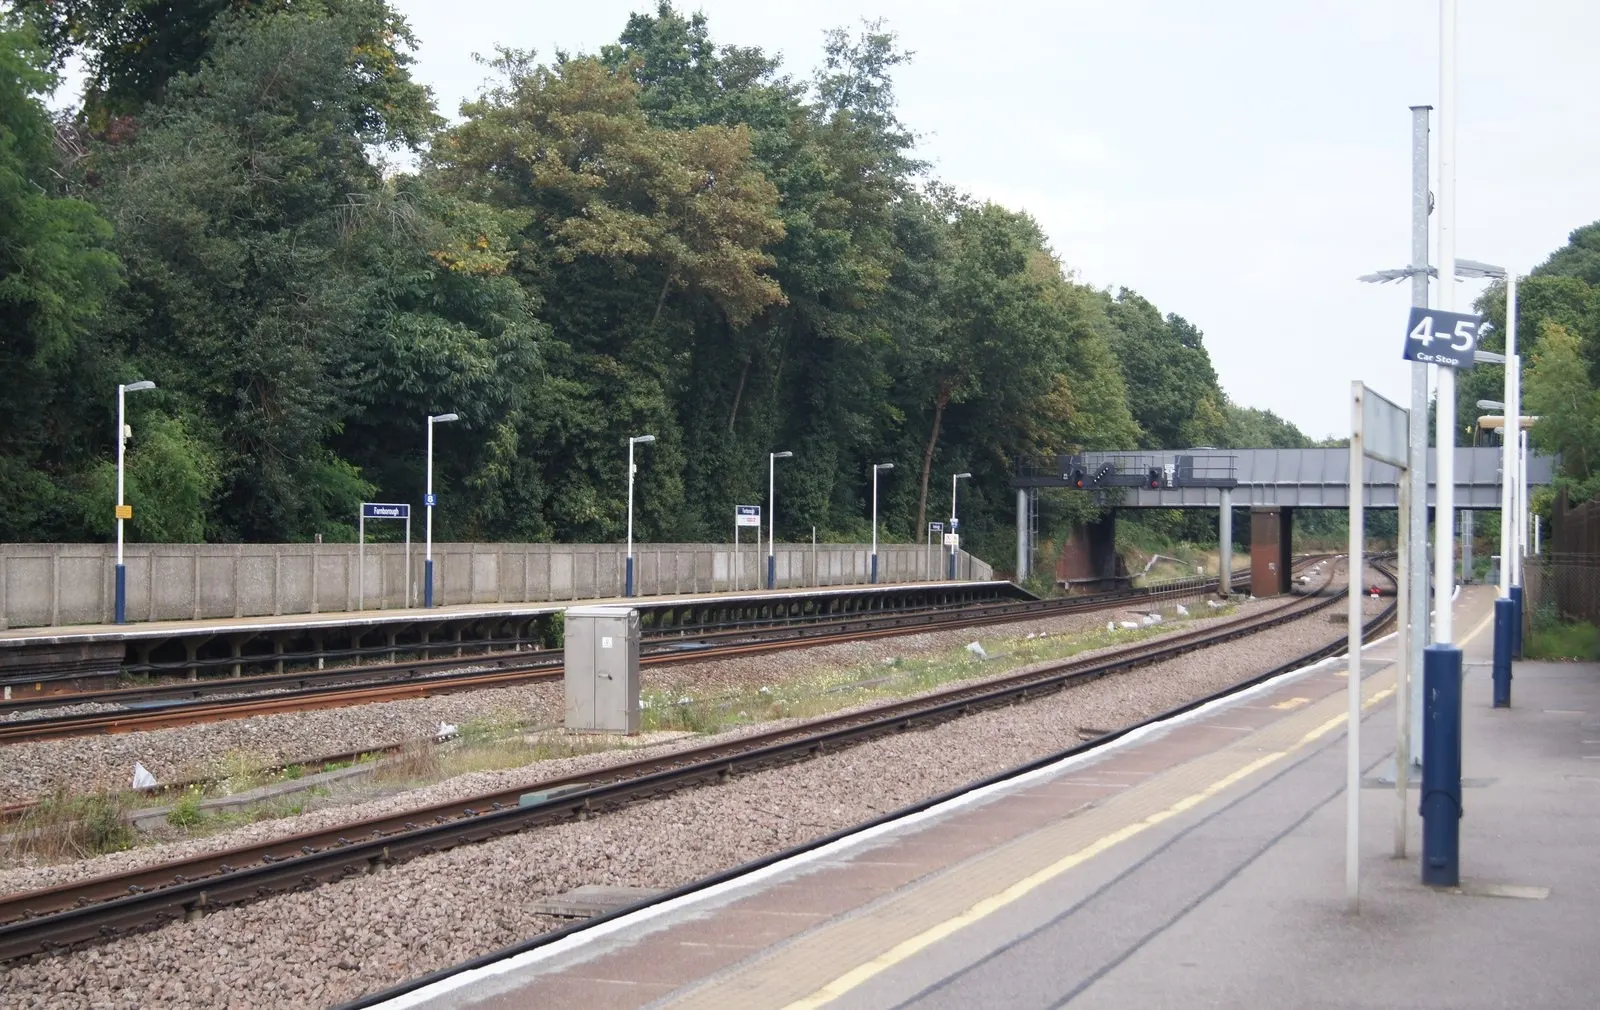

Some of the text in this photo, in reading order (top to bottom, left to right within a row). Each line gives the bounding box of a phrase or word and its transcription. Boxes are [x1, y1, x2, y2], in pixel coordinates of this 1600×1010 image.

[1409, 316, 1475, 351] 4-5
[1416, 352, 1459, 365] Car Stop
[427, 495, 433, 503] 8
